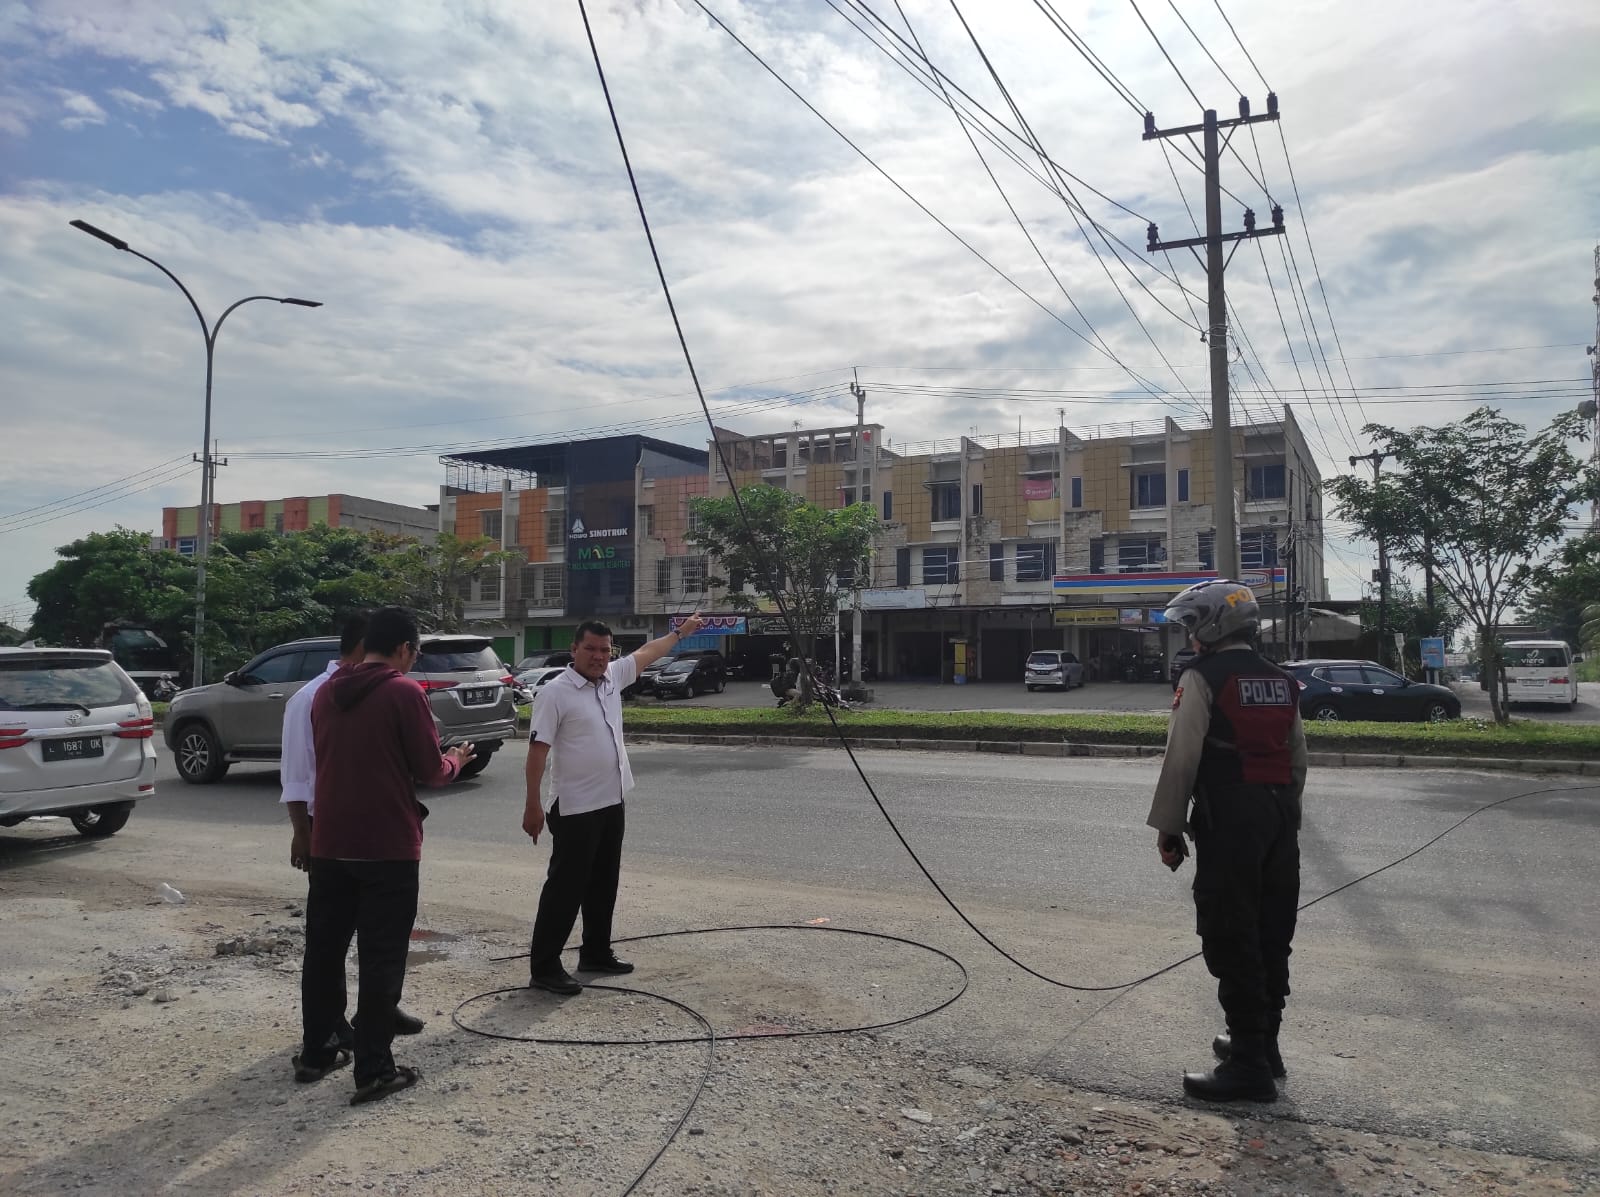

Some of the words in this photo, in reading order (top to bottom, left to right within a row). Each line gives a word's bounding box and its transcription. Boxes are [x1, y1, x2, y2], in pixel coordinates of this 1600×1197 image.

[589, 528, 628, 538] SINOTRUK
[1241, 681, 1289, 704] POLISI
[63, 741, 83, 752] 1687
